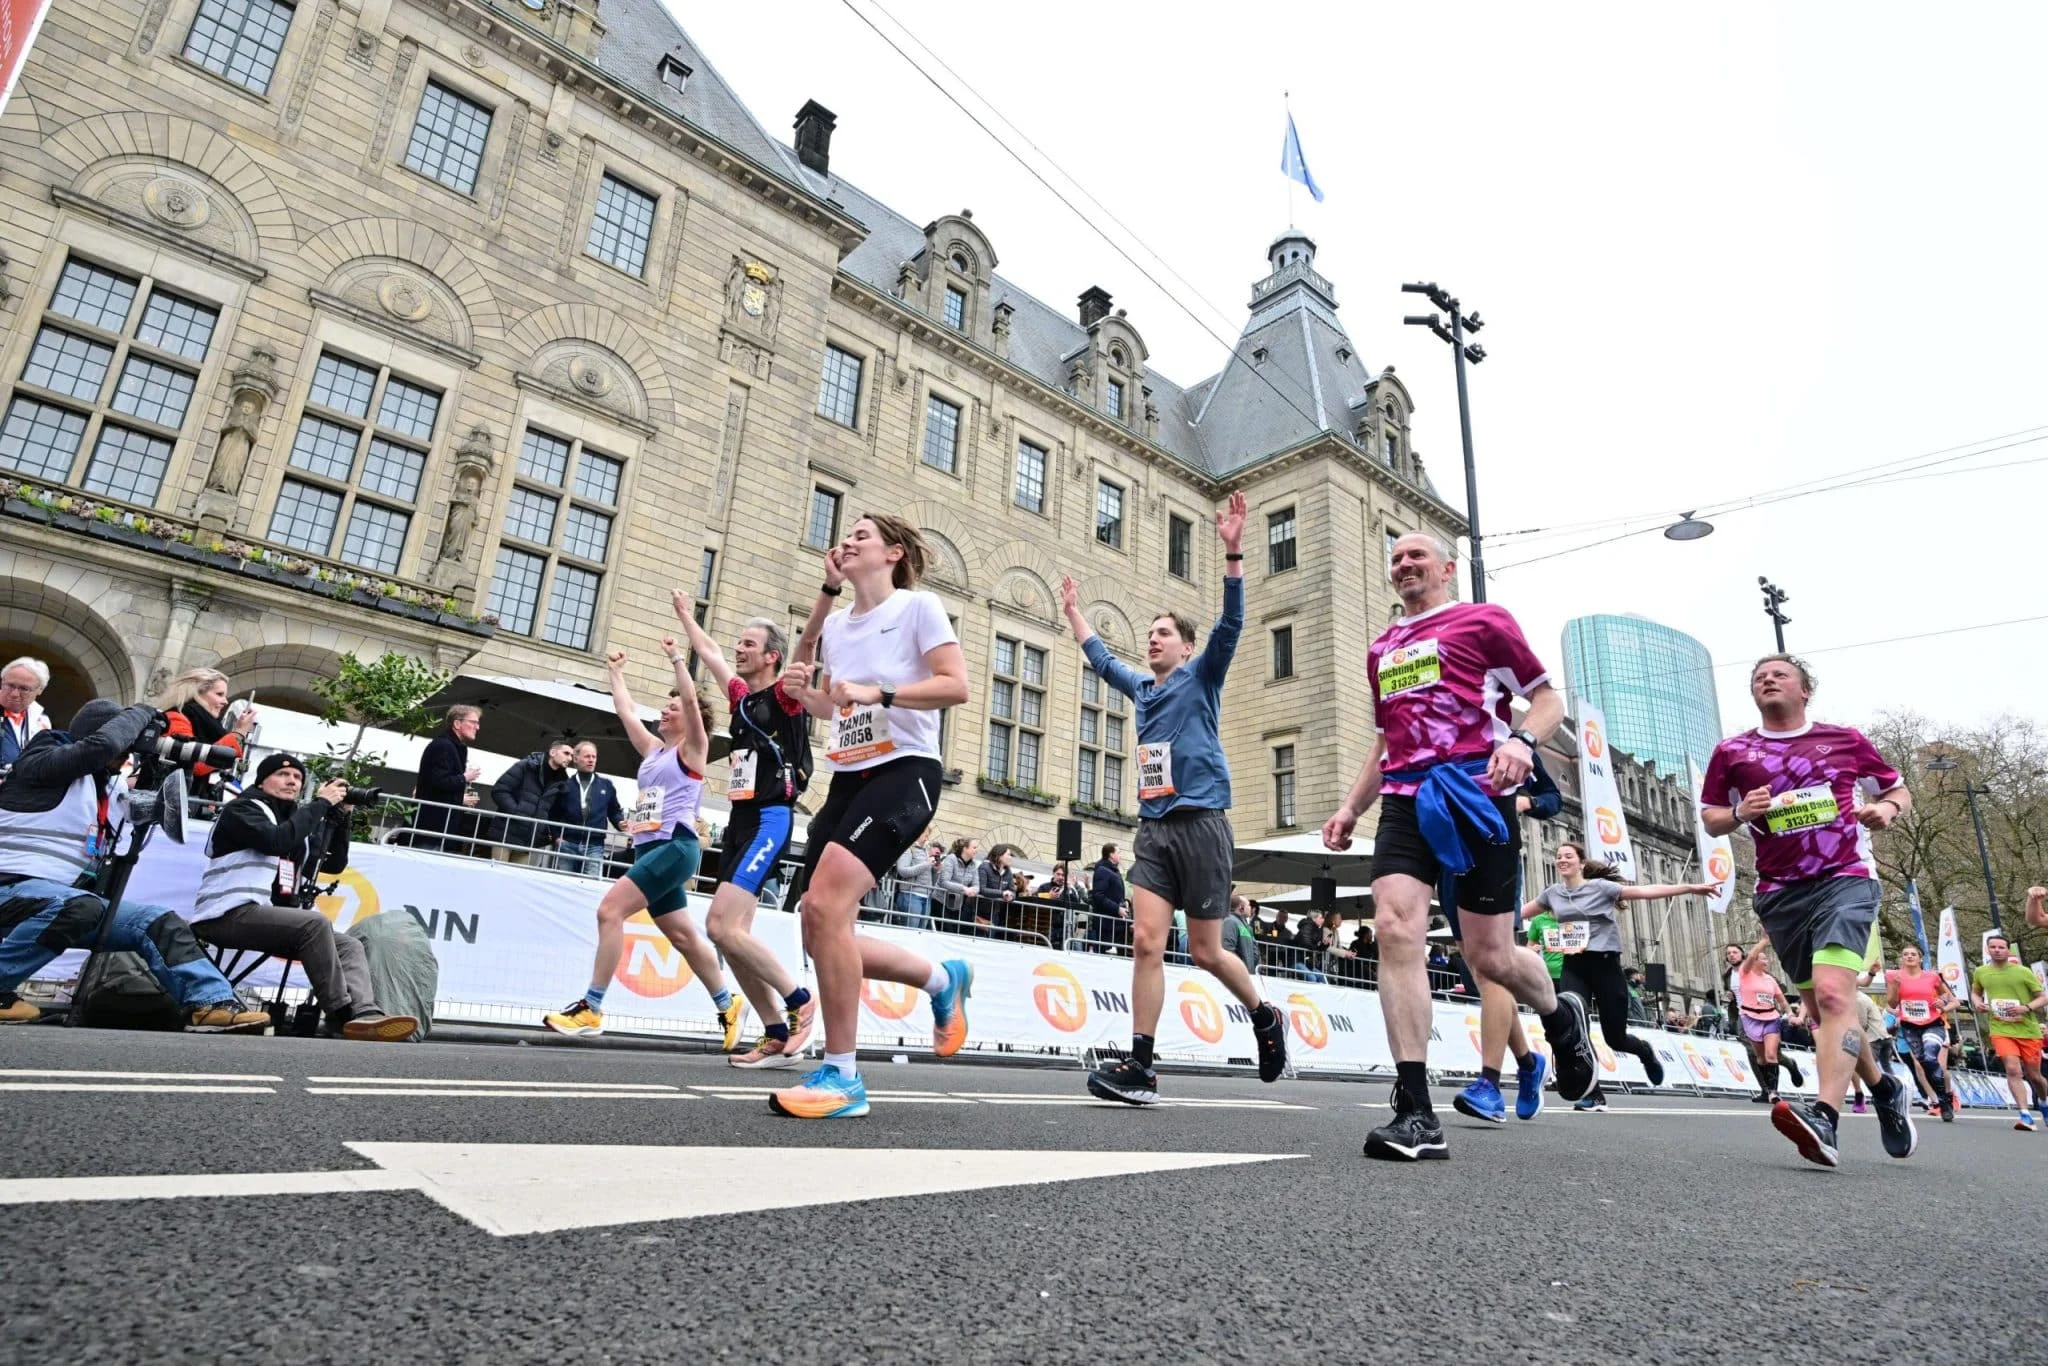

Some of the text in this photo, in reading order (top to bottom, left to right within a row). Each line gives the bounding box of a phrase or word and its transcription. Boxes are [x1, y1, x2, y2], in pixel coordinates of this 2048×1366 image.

[1379, 664, 1414, 682] Stichting
[1415, 655, 1437, 669] Dada
[1391, 674, 1419, 690] 31325
[838, 710, 872, 733] MANON
[840, 727, 873, 748] 18058
[1149, 749, 1163, 758] NN
[1809, 799, 1836, 811] Dada
[1785, 813, 1818, 828] 31325
[1091, 989, 1129, 1014] NN
[1328, 1014, 1355, 1033] NN
